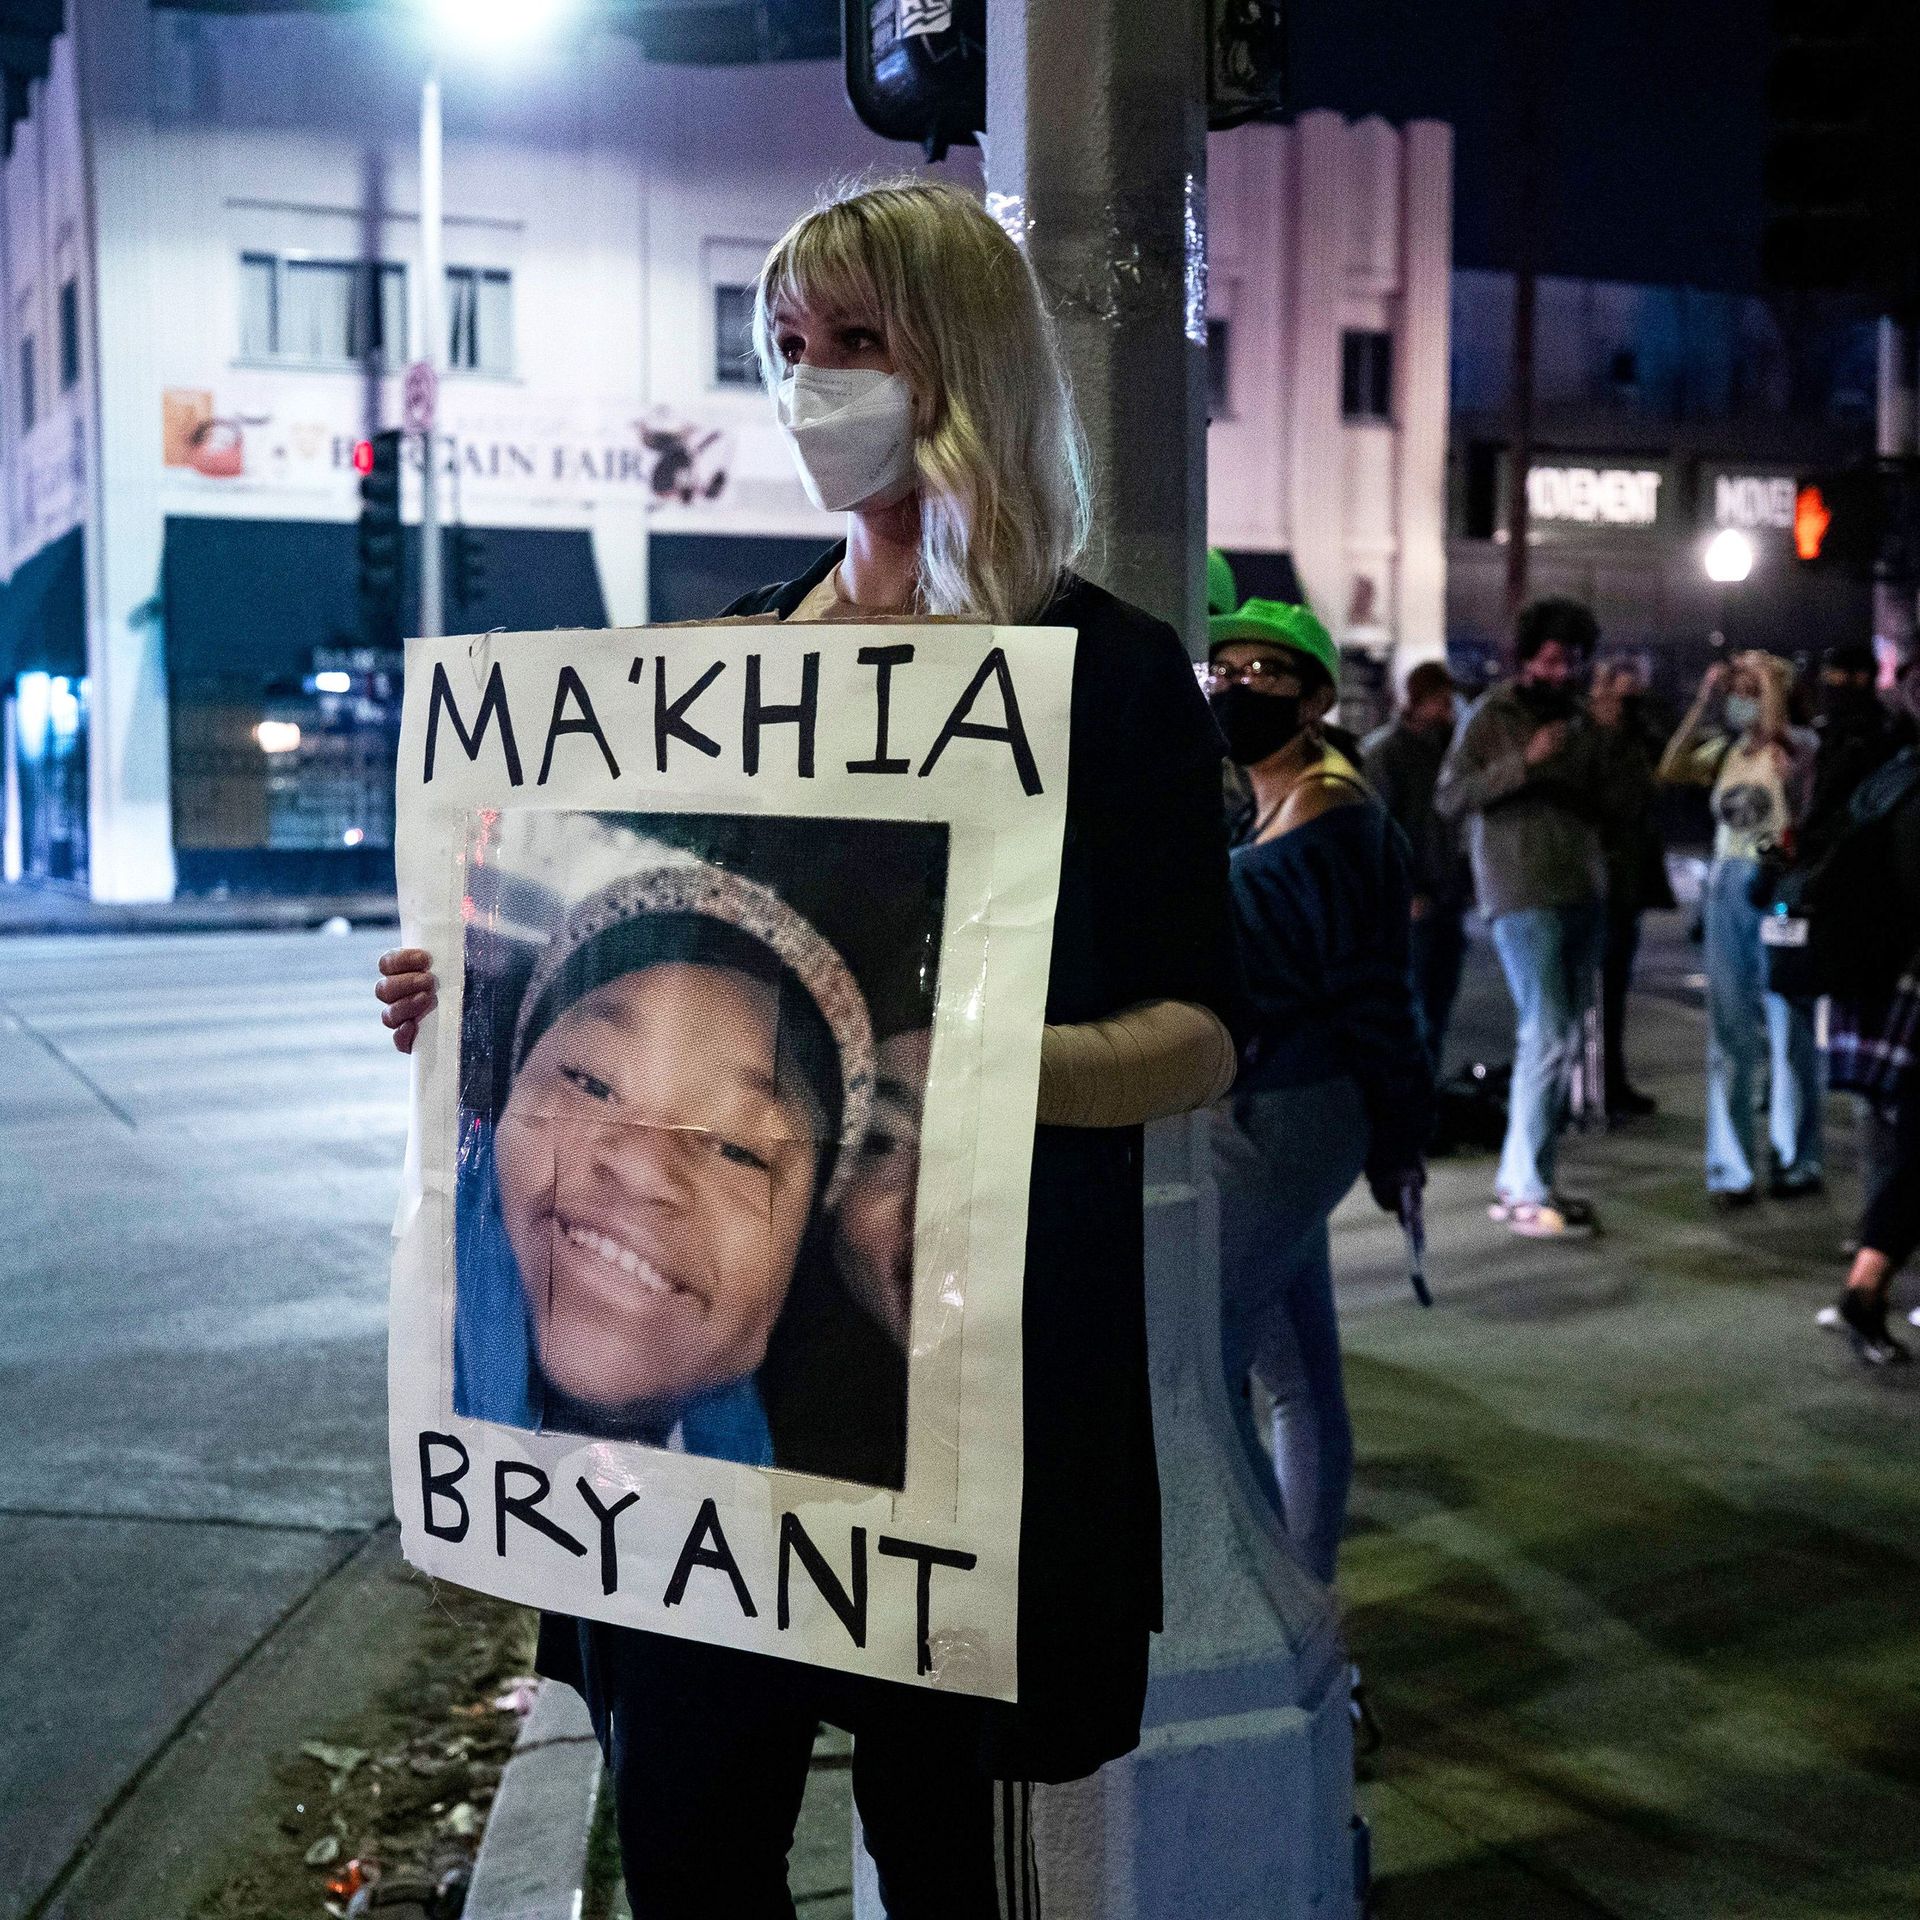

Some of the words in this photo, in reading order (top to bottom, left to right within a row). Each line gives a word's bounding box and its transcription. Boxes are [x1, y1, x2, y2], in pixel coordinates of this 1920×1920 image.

[329, 434, 537, 478] BRGAIN
[551, 443, 648, 483] FAIR
[423, 644, 1045, 797] MA'KHIA
[419, 1431, 978, 1676] BRYANT
